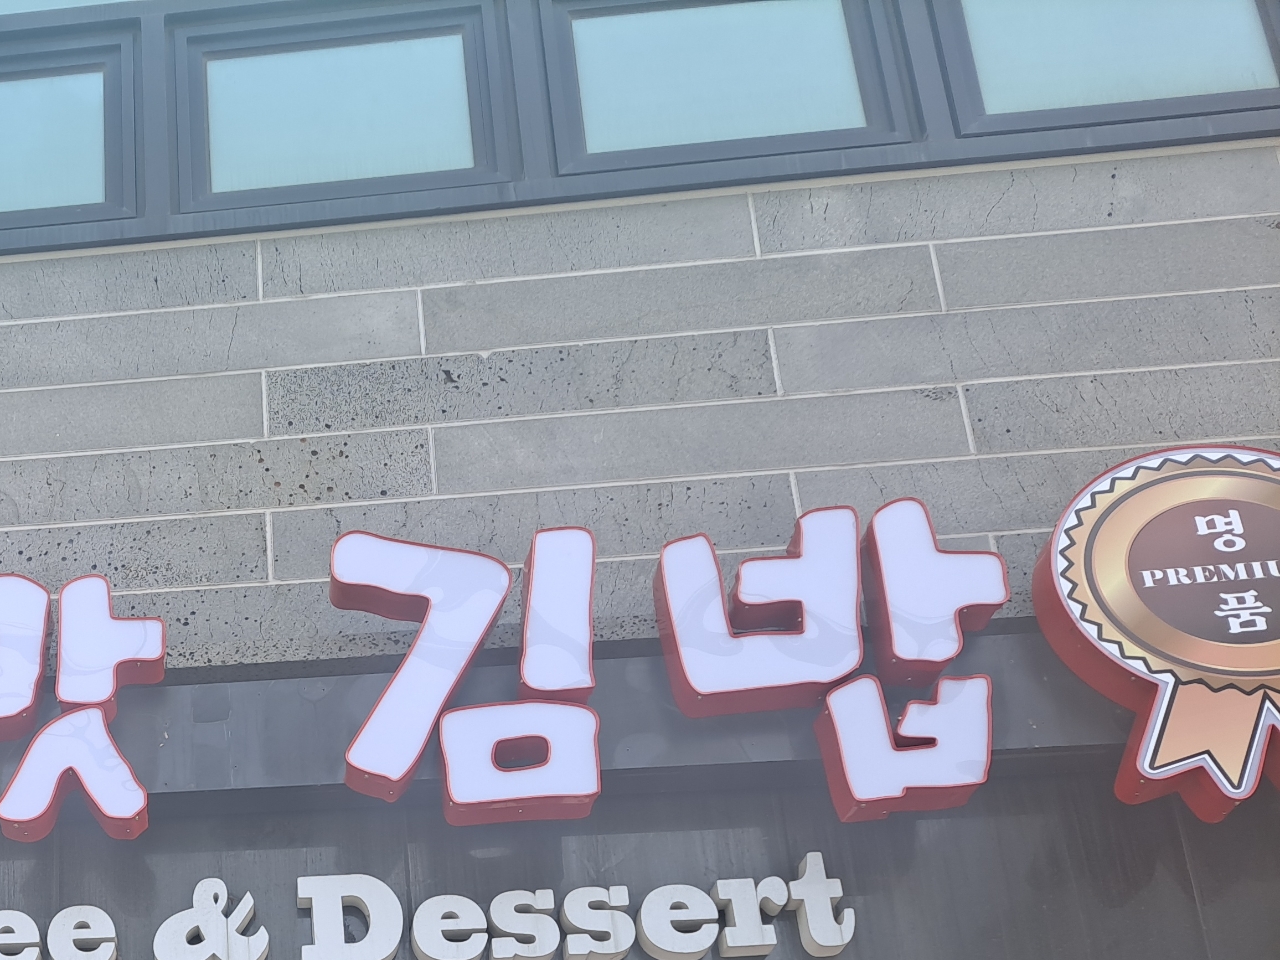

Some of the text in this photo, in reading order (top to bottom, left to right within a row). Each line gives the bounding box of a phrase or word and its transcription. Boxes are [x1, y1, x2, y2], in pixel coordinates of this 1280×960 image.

[1194, 509, 1246, 552] 명
[1214, 589, 1273, 634] 품
[328, 497, 1012, 825] 김밥
